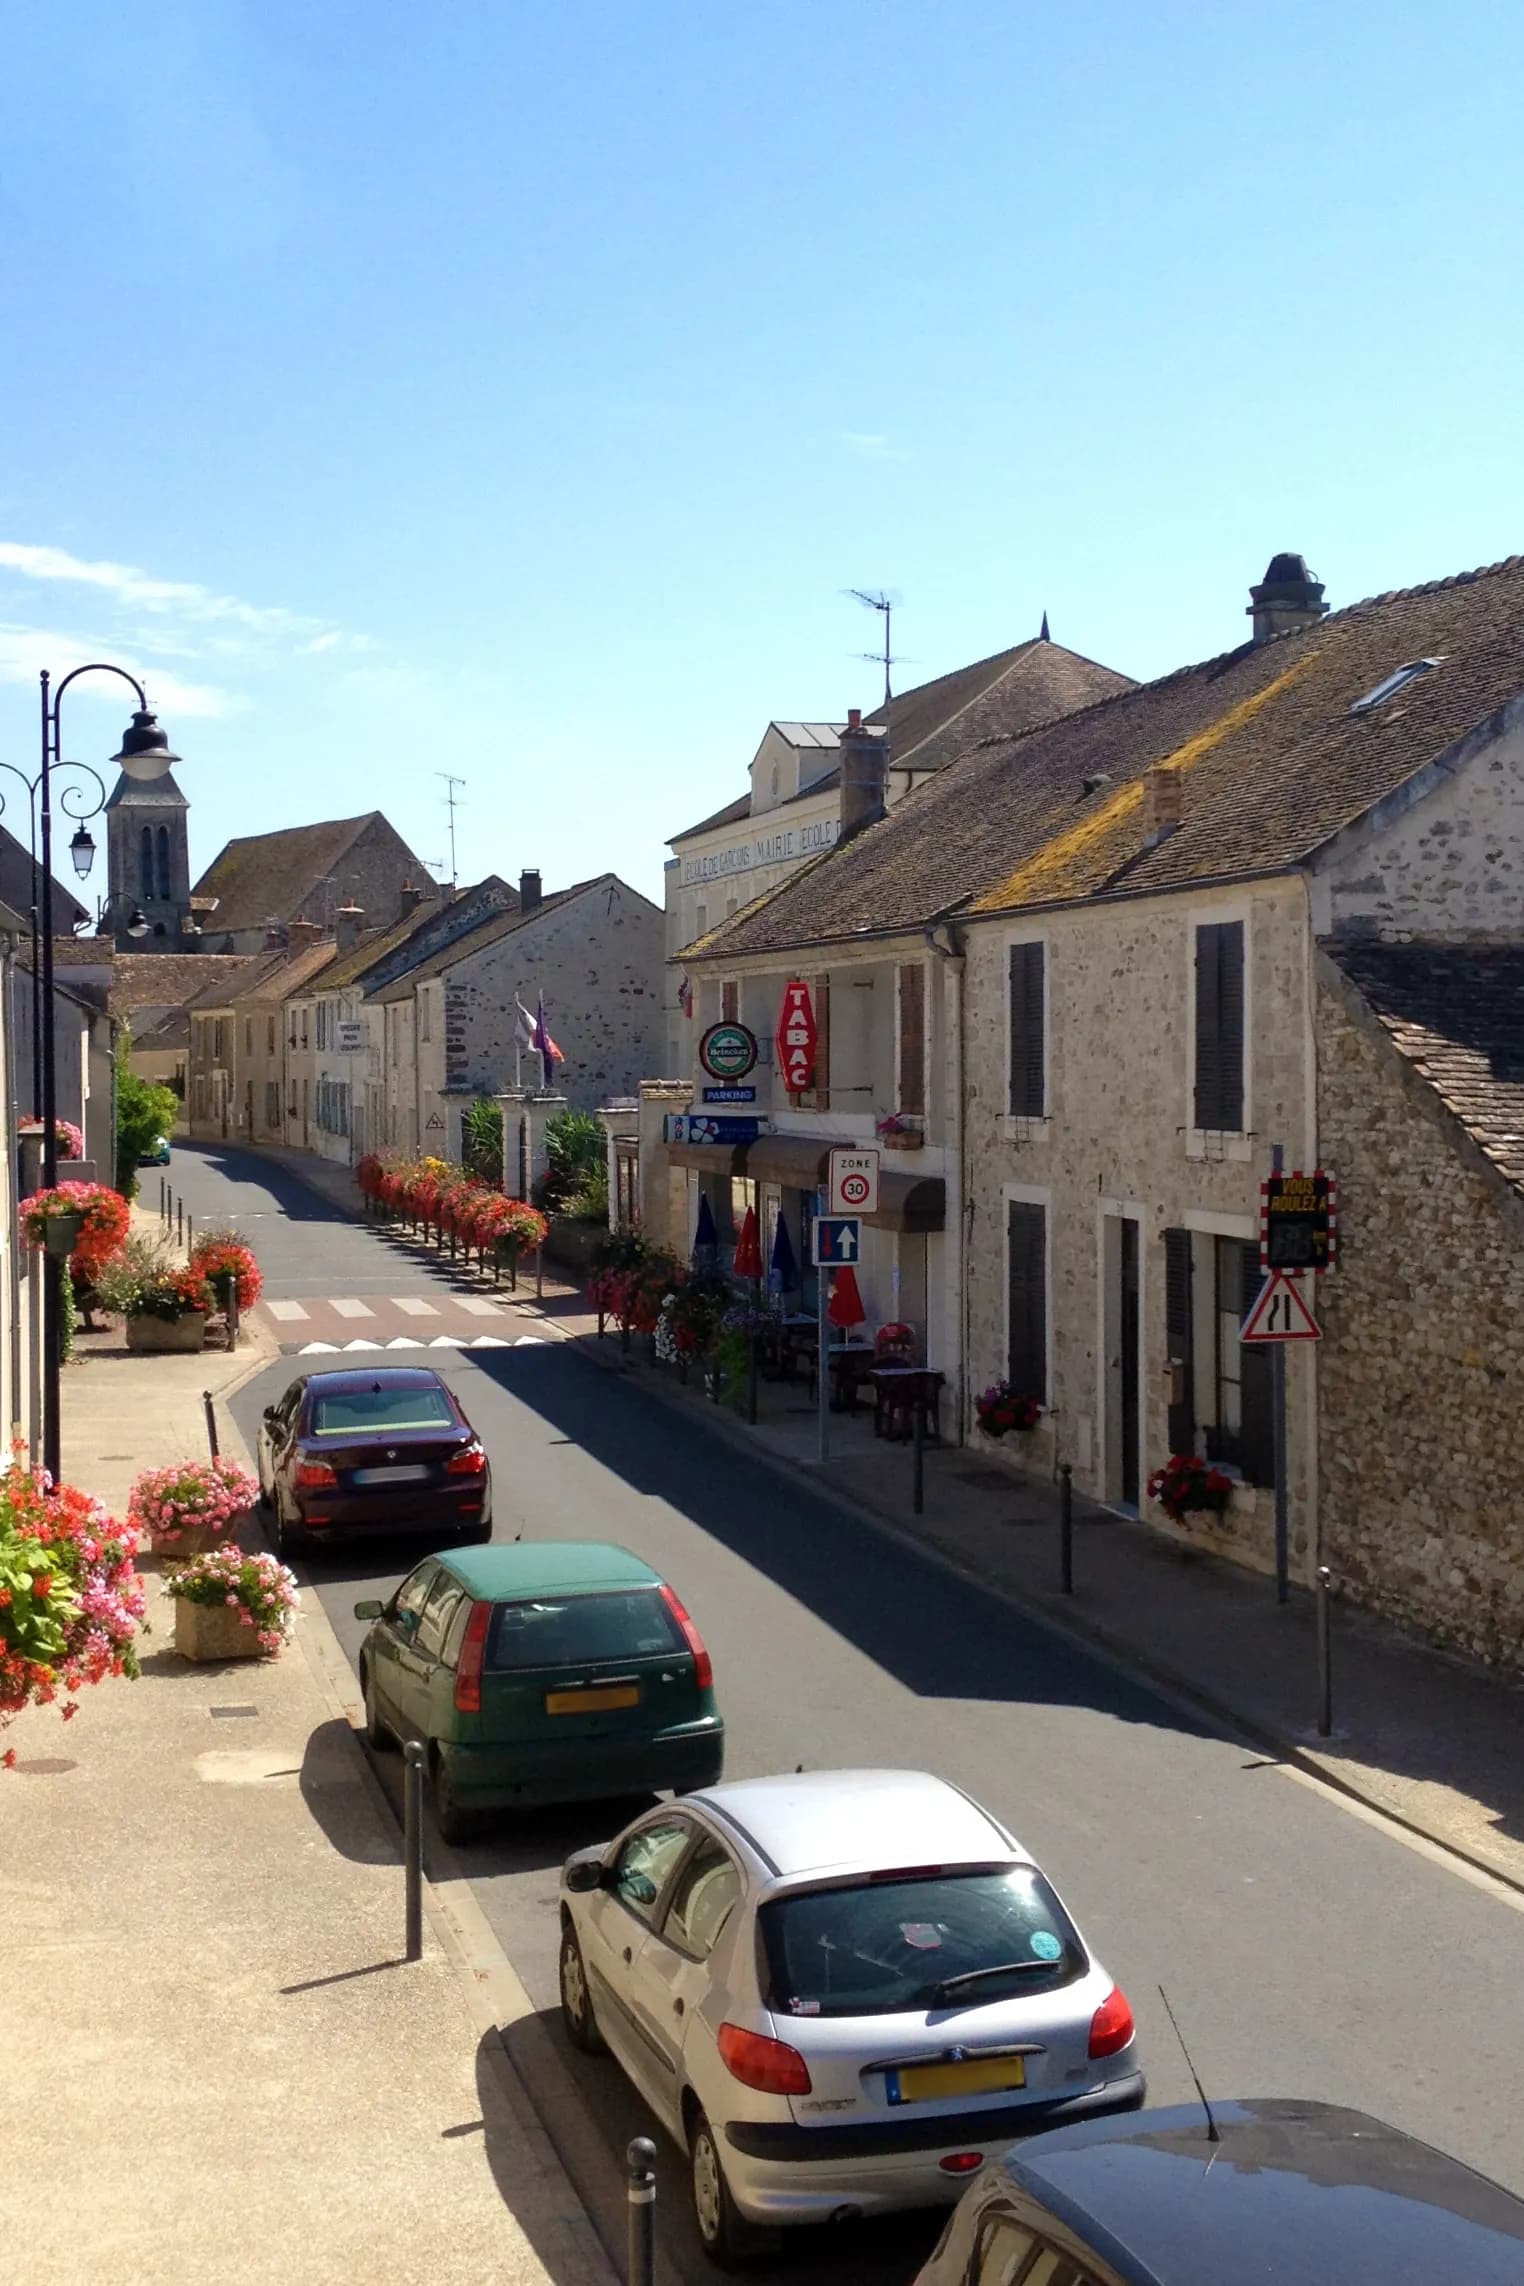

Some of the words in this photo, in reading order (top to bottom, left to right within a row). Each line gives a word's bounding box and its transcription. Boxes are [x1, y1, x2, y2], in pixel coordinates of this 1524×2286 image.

[801, 821, 832, 850] ECOLE
[757, 832, 793, 860] MAIRIE
[786, 989, 809, 1086] TABAC
[706, 1090, 753, 1100] PARKING
[841, 1159, 871, 1168] ZONE
[847, 1183, 864, 1195] 30
[1282, 1179, 1314, 1195] VOUS
[1271, 1195, 1316, 1211] ROULEZ
